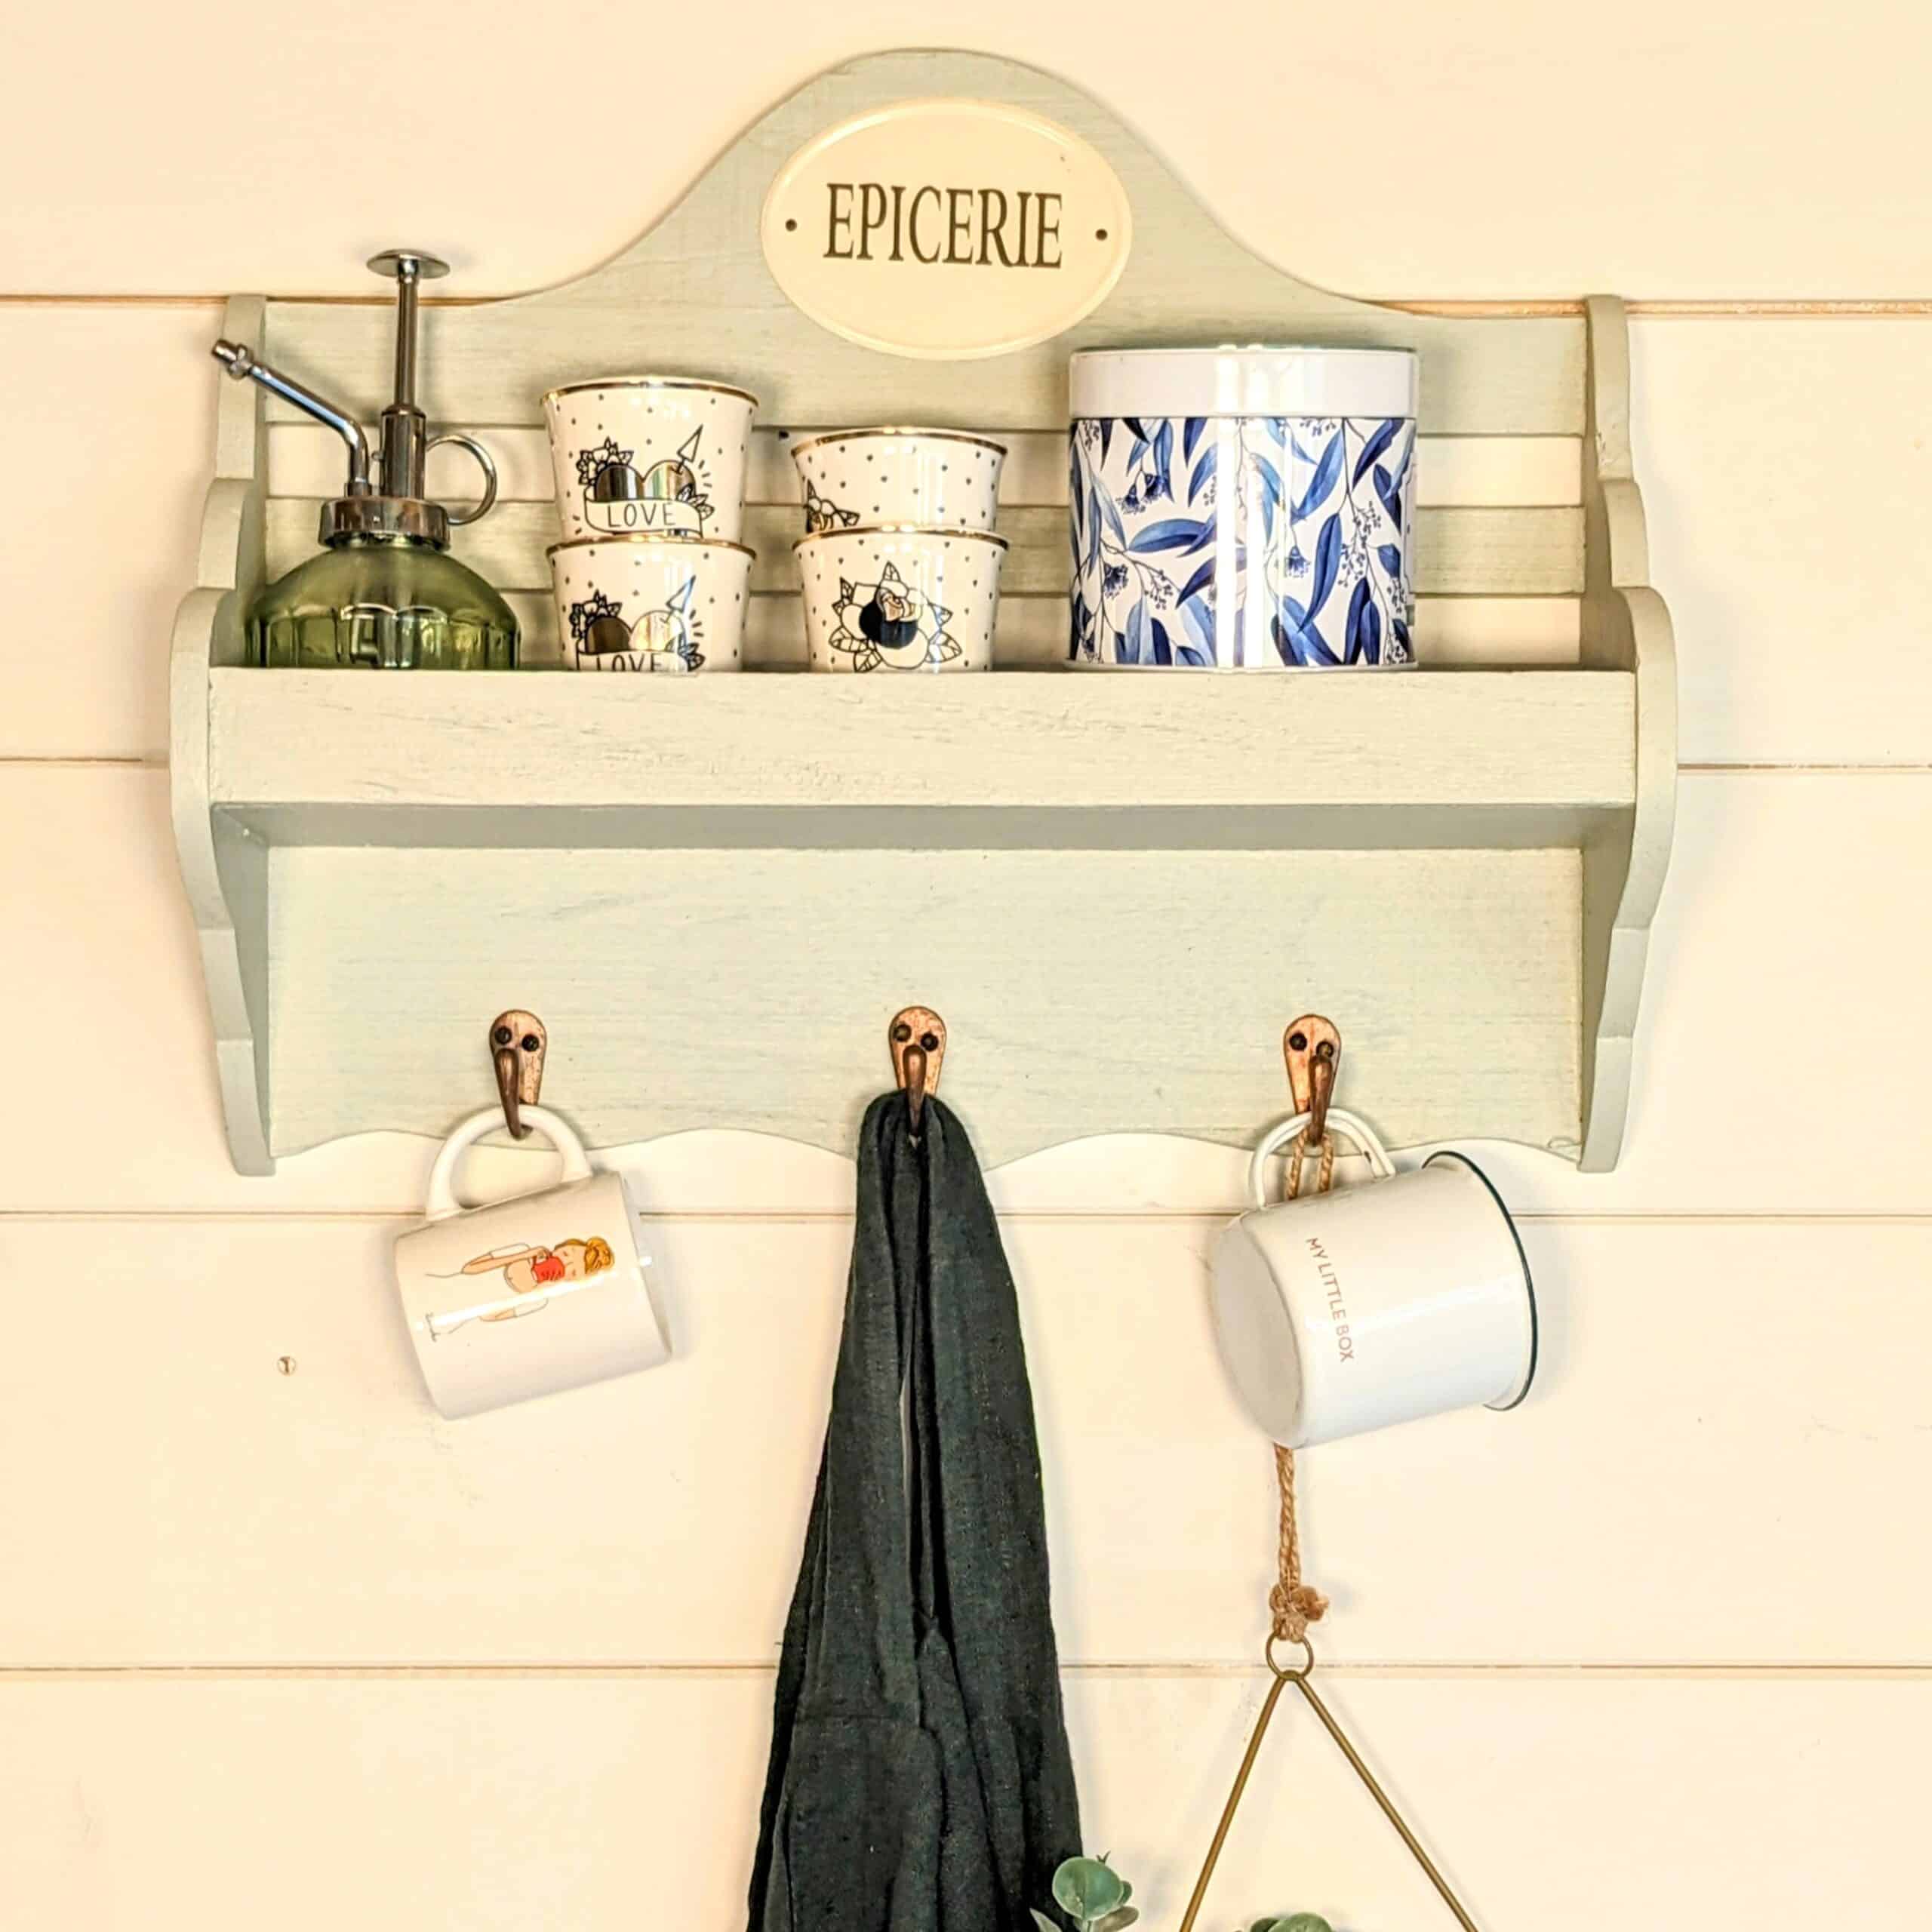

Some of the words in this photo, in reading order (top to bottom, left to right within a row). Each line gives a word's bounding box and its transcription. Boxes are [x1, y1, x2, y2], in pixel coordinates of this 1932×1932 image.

[823, 182, 1063, 269] EPICERIE
[607, 503, 676, 527] LOVE
[1306, 1238, 1328, 1258] MY
[1318, 1263, 1346, 1320] LITTLE
[1336, 1324, 1354, 1362] BOX
